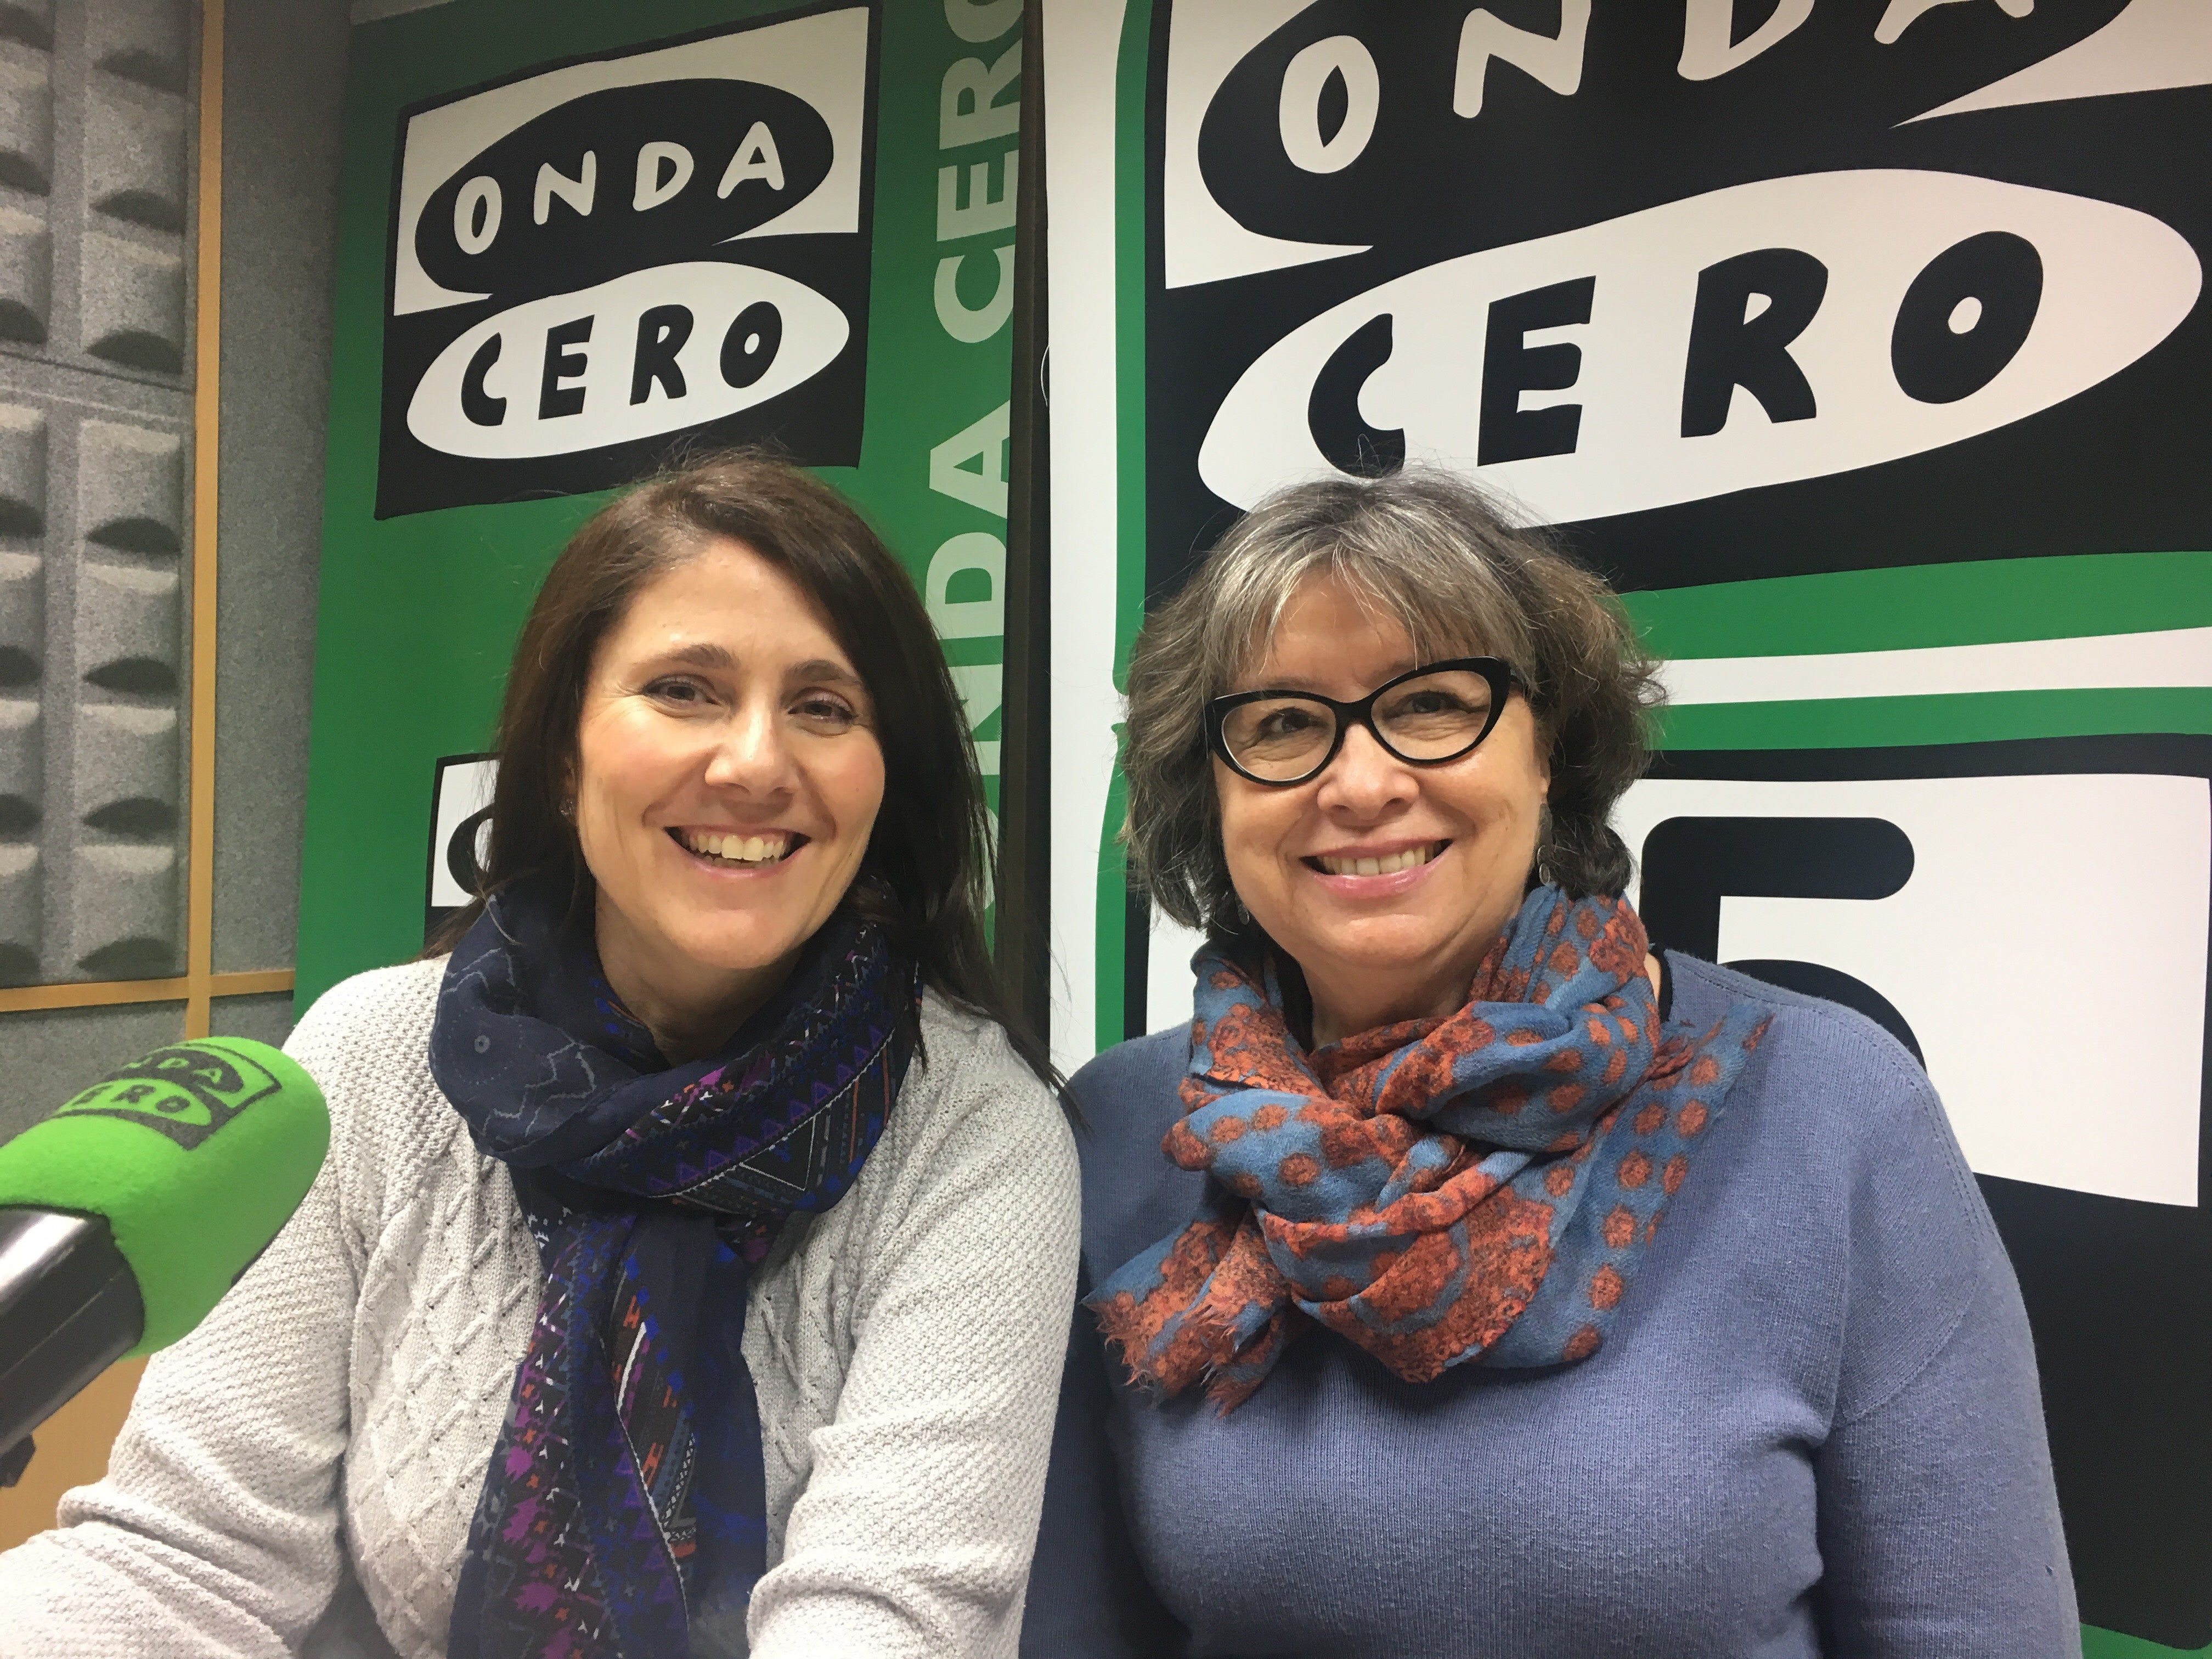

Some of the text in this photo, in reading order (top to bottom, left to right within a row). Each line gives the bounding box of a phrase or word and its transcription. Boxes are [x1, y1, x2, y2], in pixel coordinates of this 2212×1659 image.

[1278, 0, 2035, 174] OND
[453, 121, 785, 255] ONDA
[461, 300, 783, 426] CERO
[1307, 230, 2044, 479] CERO
[926, 399, 1011, 911] DA
[73, 1084, 191, 1114] ERO
